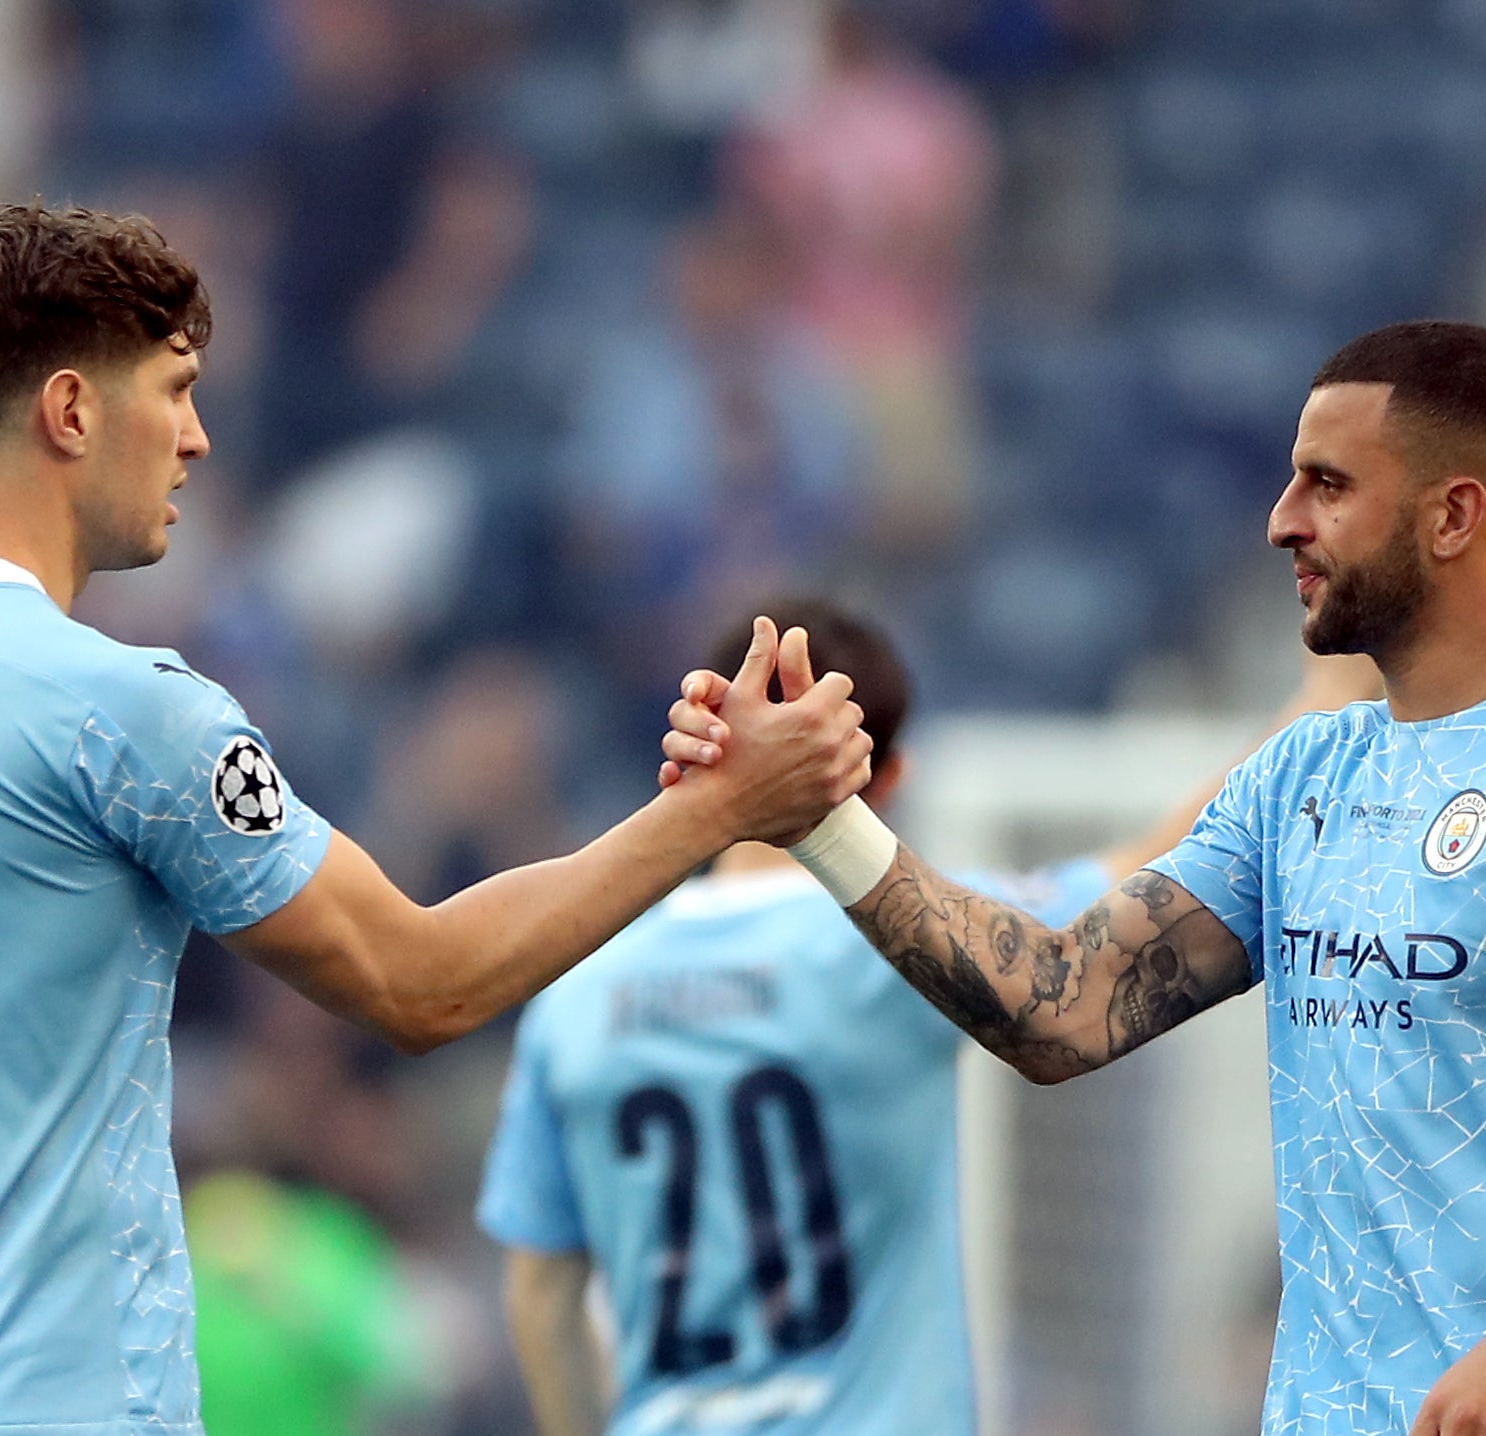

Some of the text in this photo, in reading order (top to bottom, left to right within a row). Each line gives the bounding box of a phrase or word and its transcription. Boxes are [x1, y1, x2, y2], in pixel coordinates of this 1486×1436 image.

[1440, 797, 1486, 823] MANCHESTER
[1436, 861, 1456, 870] CITY
[1280, 926, 1468, 980] TIHAD
[1288, 996, 1413, 1030] AIRWAYS
[614, 1063, 857, 1379] 20
